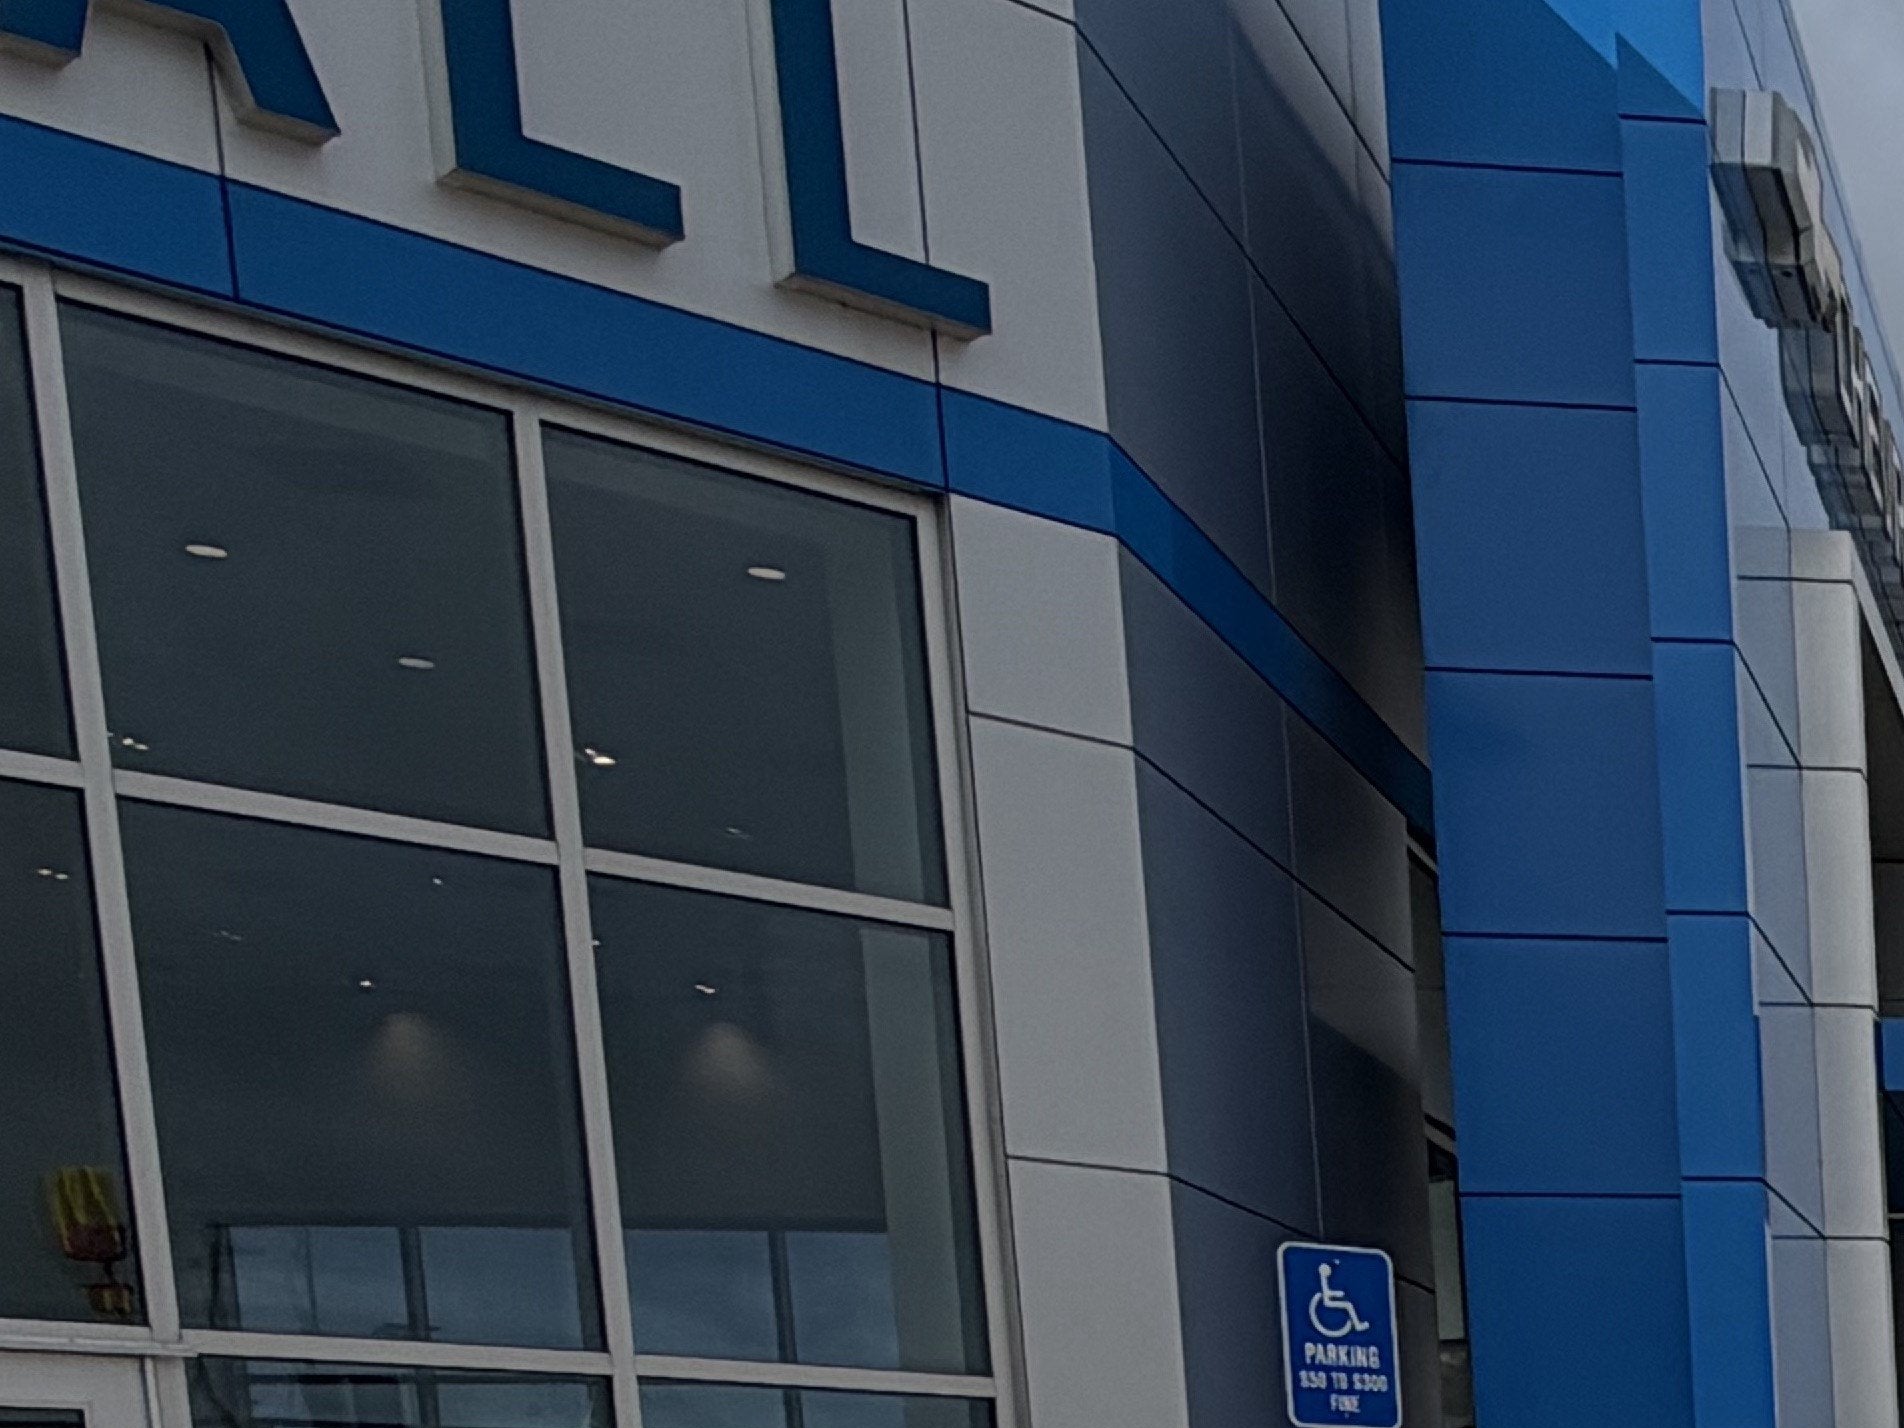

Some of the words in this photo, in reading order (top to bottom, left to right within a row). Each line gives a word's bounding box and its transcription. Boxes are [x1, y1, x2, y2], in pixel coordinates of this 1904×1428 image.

[1304, 1342, 1380, 1369] PARKING
[1330, 1371, 1348, 1390] TO
[1330, 1393, 1360, 1413] FINE
